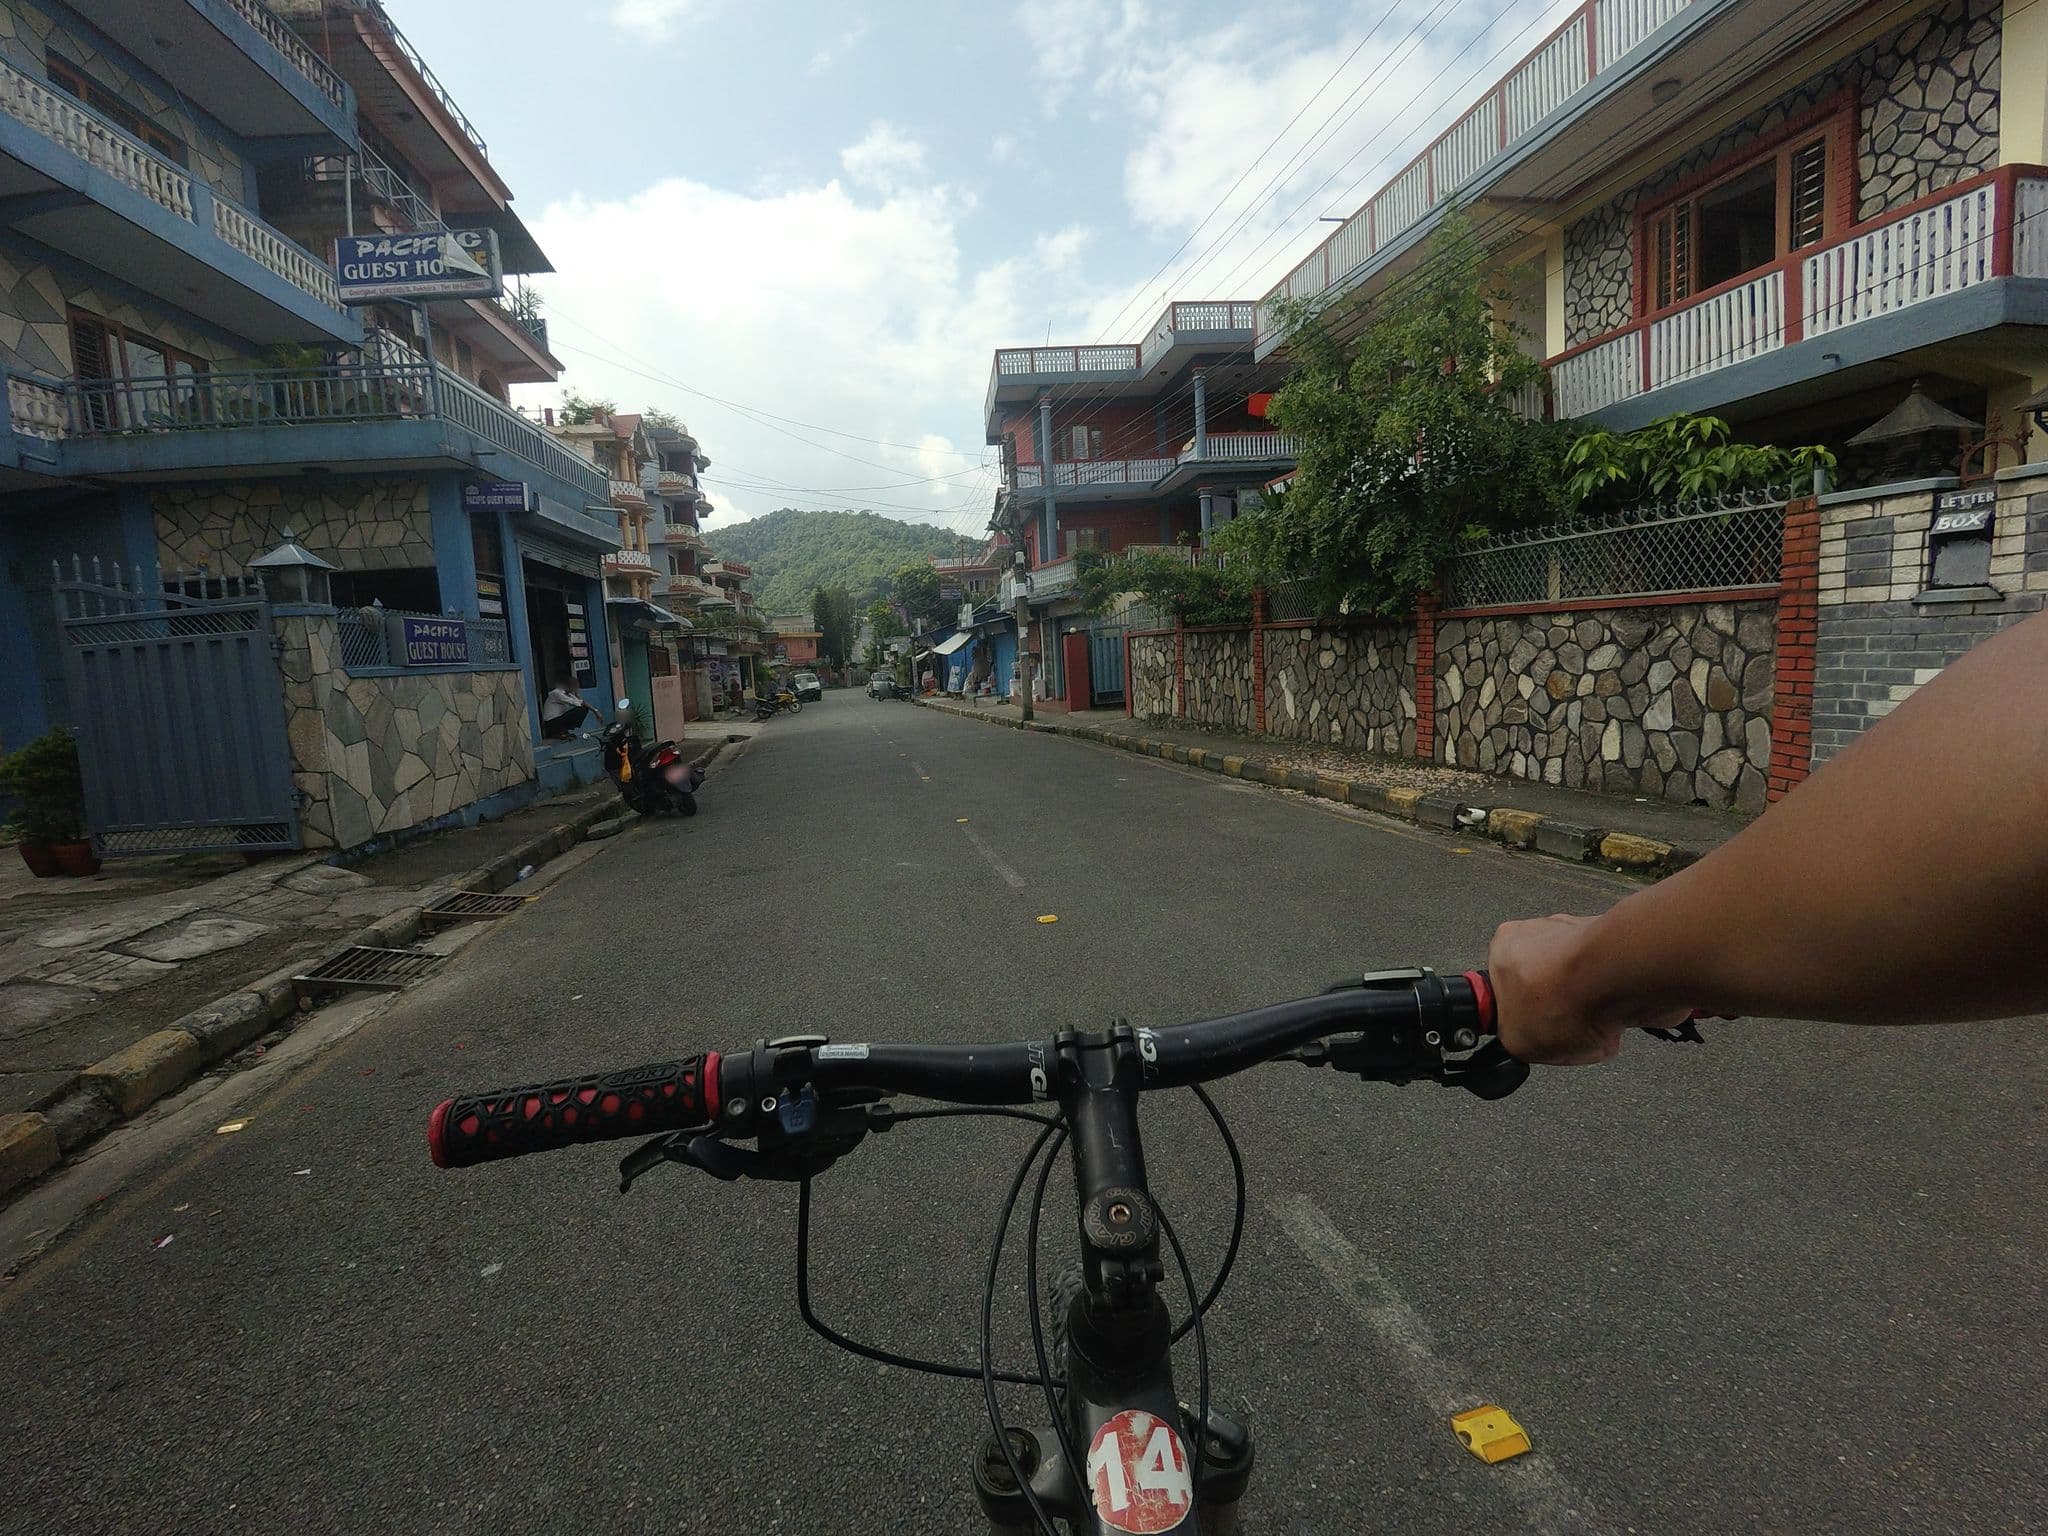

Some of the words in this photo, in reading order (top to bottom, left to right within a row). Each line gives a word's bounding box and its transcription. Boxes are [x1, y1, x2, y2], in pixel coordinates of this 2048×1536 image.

[344, 261, 408, 280] GUEST
[1940, 491, 1995, 509] LETTER
[1936, 511, 1985, 530] BOX
[413, 624, 460, 638] PACIFIC
[409, 641, 438, 660] GUEST
[440, 643, 467, 660] HOUSE
[1089, 1427, 1186, 1512] 14
